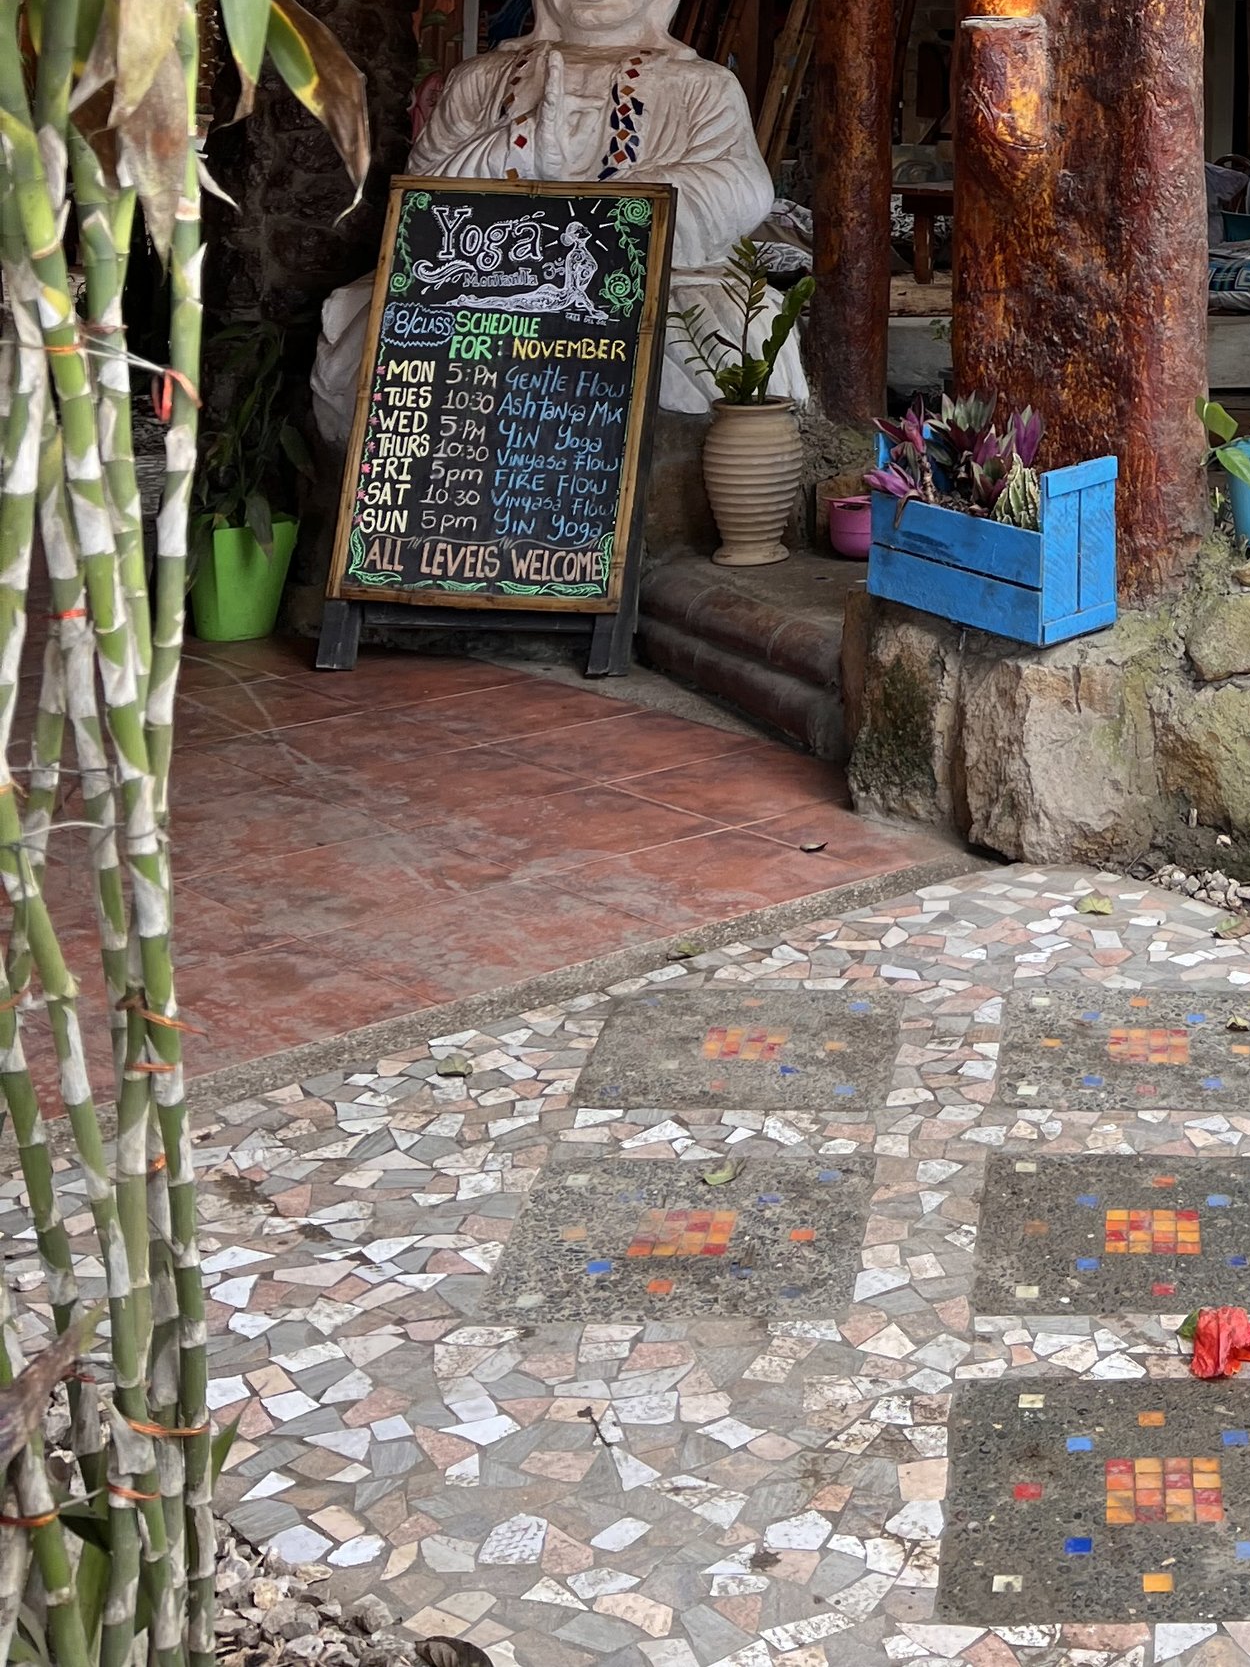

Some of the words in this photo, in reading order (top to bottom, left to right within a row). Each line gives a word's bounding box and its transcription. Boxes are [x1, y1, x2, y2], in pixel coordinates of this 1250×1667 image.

[432, 205, 544, 271] Yoga
[455, 311, 541, 338] SCHEDULE
[512, 337, 626, 362] NOVEMBER
[386, 360, 435, 383] MON
[384, 387, 432, 407] TUES
[441, 389, 494, 414] 10:30
[378, 410, 428, 433] WED
[376, 434, 431, 457] THURS
[433, 439, 489, 462] 10:30
[371, 457, 412, 480] FRI
[364, 482, 411, 505] SAT
[360, 509, 408, 533] SUN
[364, 538, 404, 571] ALL
[420, 542, 500, 577] LEVELS
[512, 548, 603, 582] WELCOME
